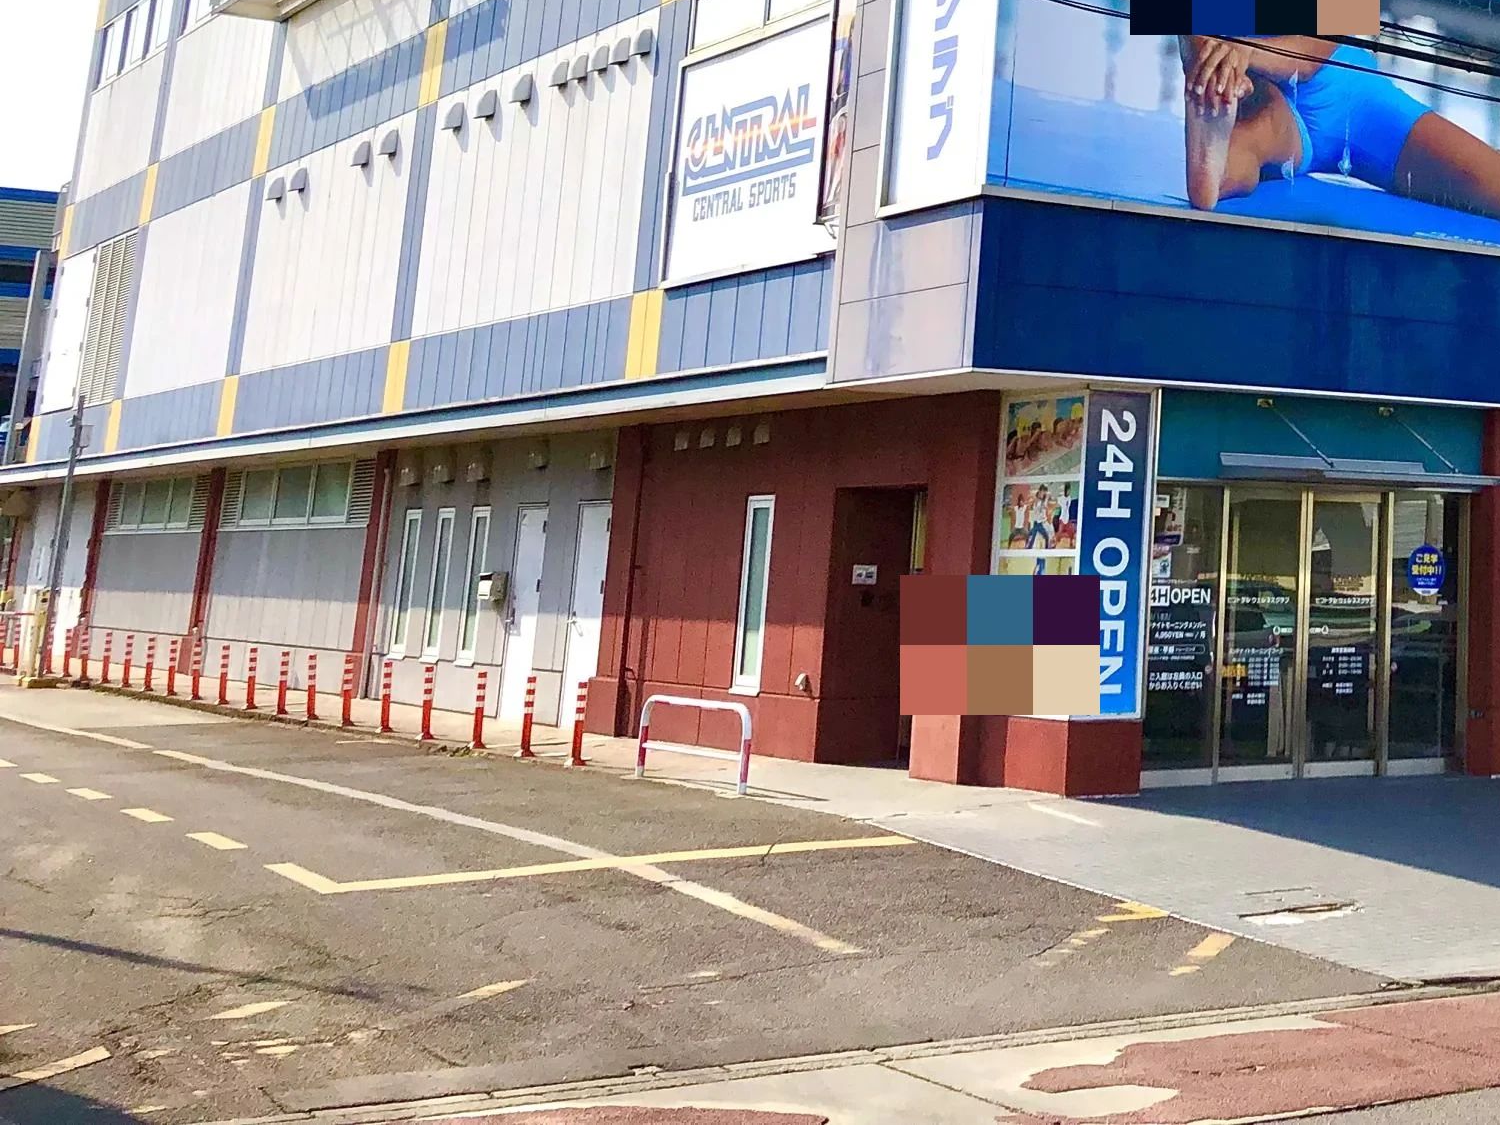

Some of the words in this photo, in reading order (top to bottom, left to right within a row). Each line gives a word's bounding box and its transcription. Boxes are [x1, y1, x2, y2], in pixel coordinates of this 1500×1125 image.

[682, 83, 816, 196] CENTRAL
[693, 189, 743, 222] CENTRAL
[748, 172, 797, 208] SPORTS
[1095, 408, 1137, 519] 24H
[1092, 537, 1129, 695] OPEN
[1151, 587, 1169, 604] 4H
[1170, 587, 1211, 604] OPEN
